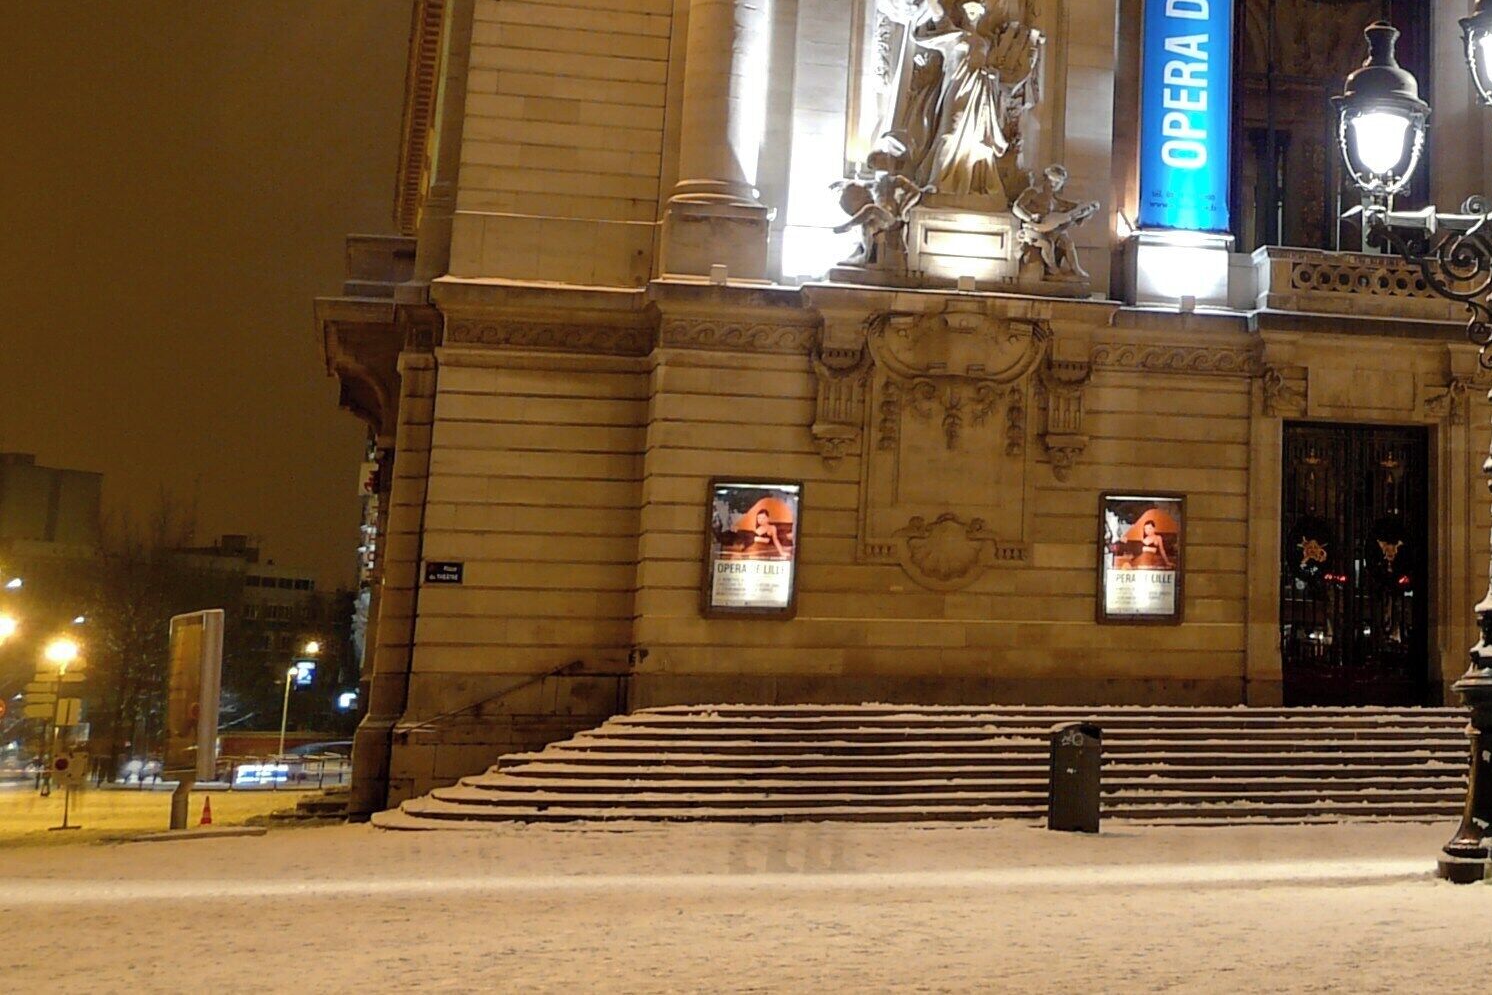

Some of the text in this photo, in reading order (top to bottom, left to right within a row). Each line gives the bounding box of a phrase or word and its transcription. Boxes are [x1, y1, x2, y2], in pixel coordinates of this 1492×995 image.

[1161, 34, 1209, 169] OPERA
[717, 562, 747, 574] OPERA
[1151, 573, 1173, 584] LILLE
